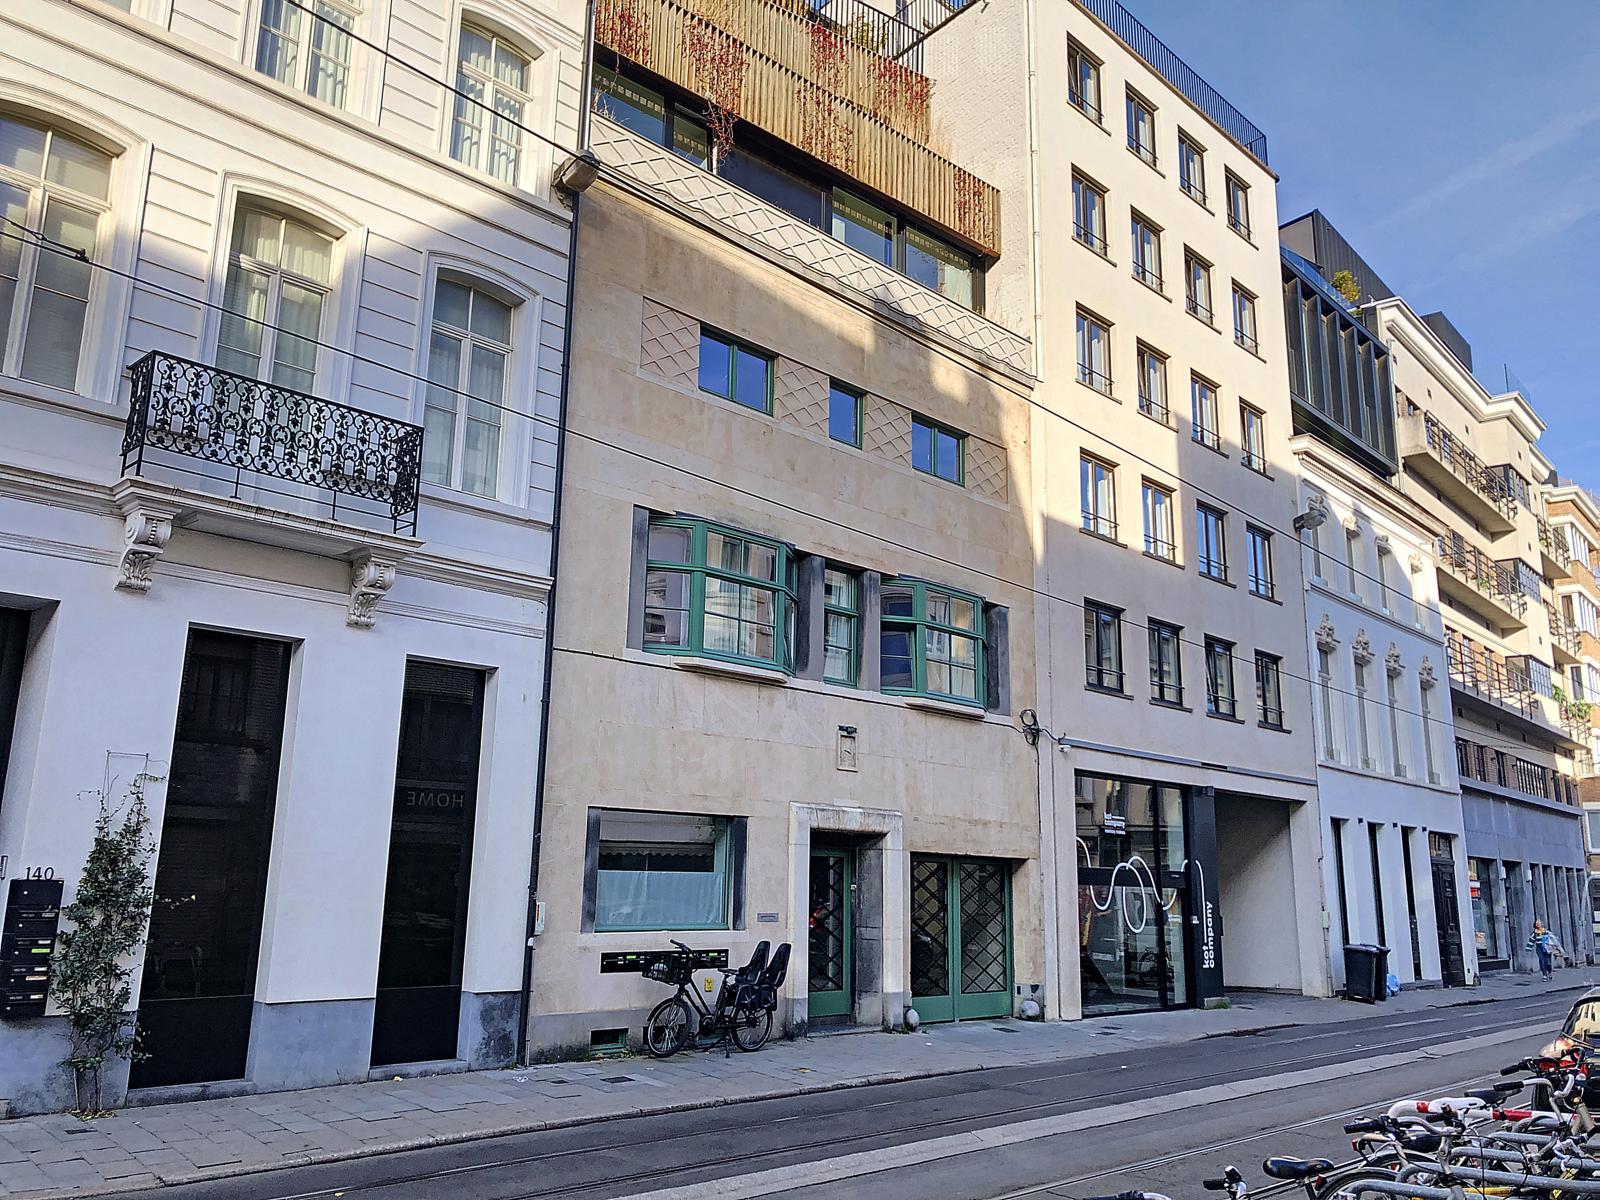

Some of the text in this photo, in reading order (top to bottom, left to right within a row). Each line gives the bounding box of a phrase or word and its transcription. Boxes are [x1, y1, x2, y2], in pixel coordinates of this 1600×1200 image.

[26, 866, 54, 880] 140
[1206, 901, 1215, 969] company
[1202, 945, 1210, 969] kot
